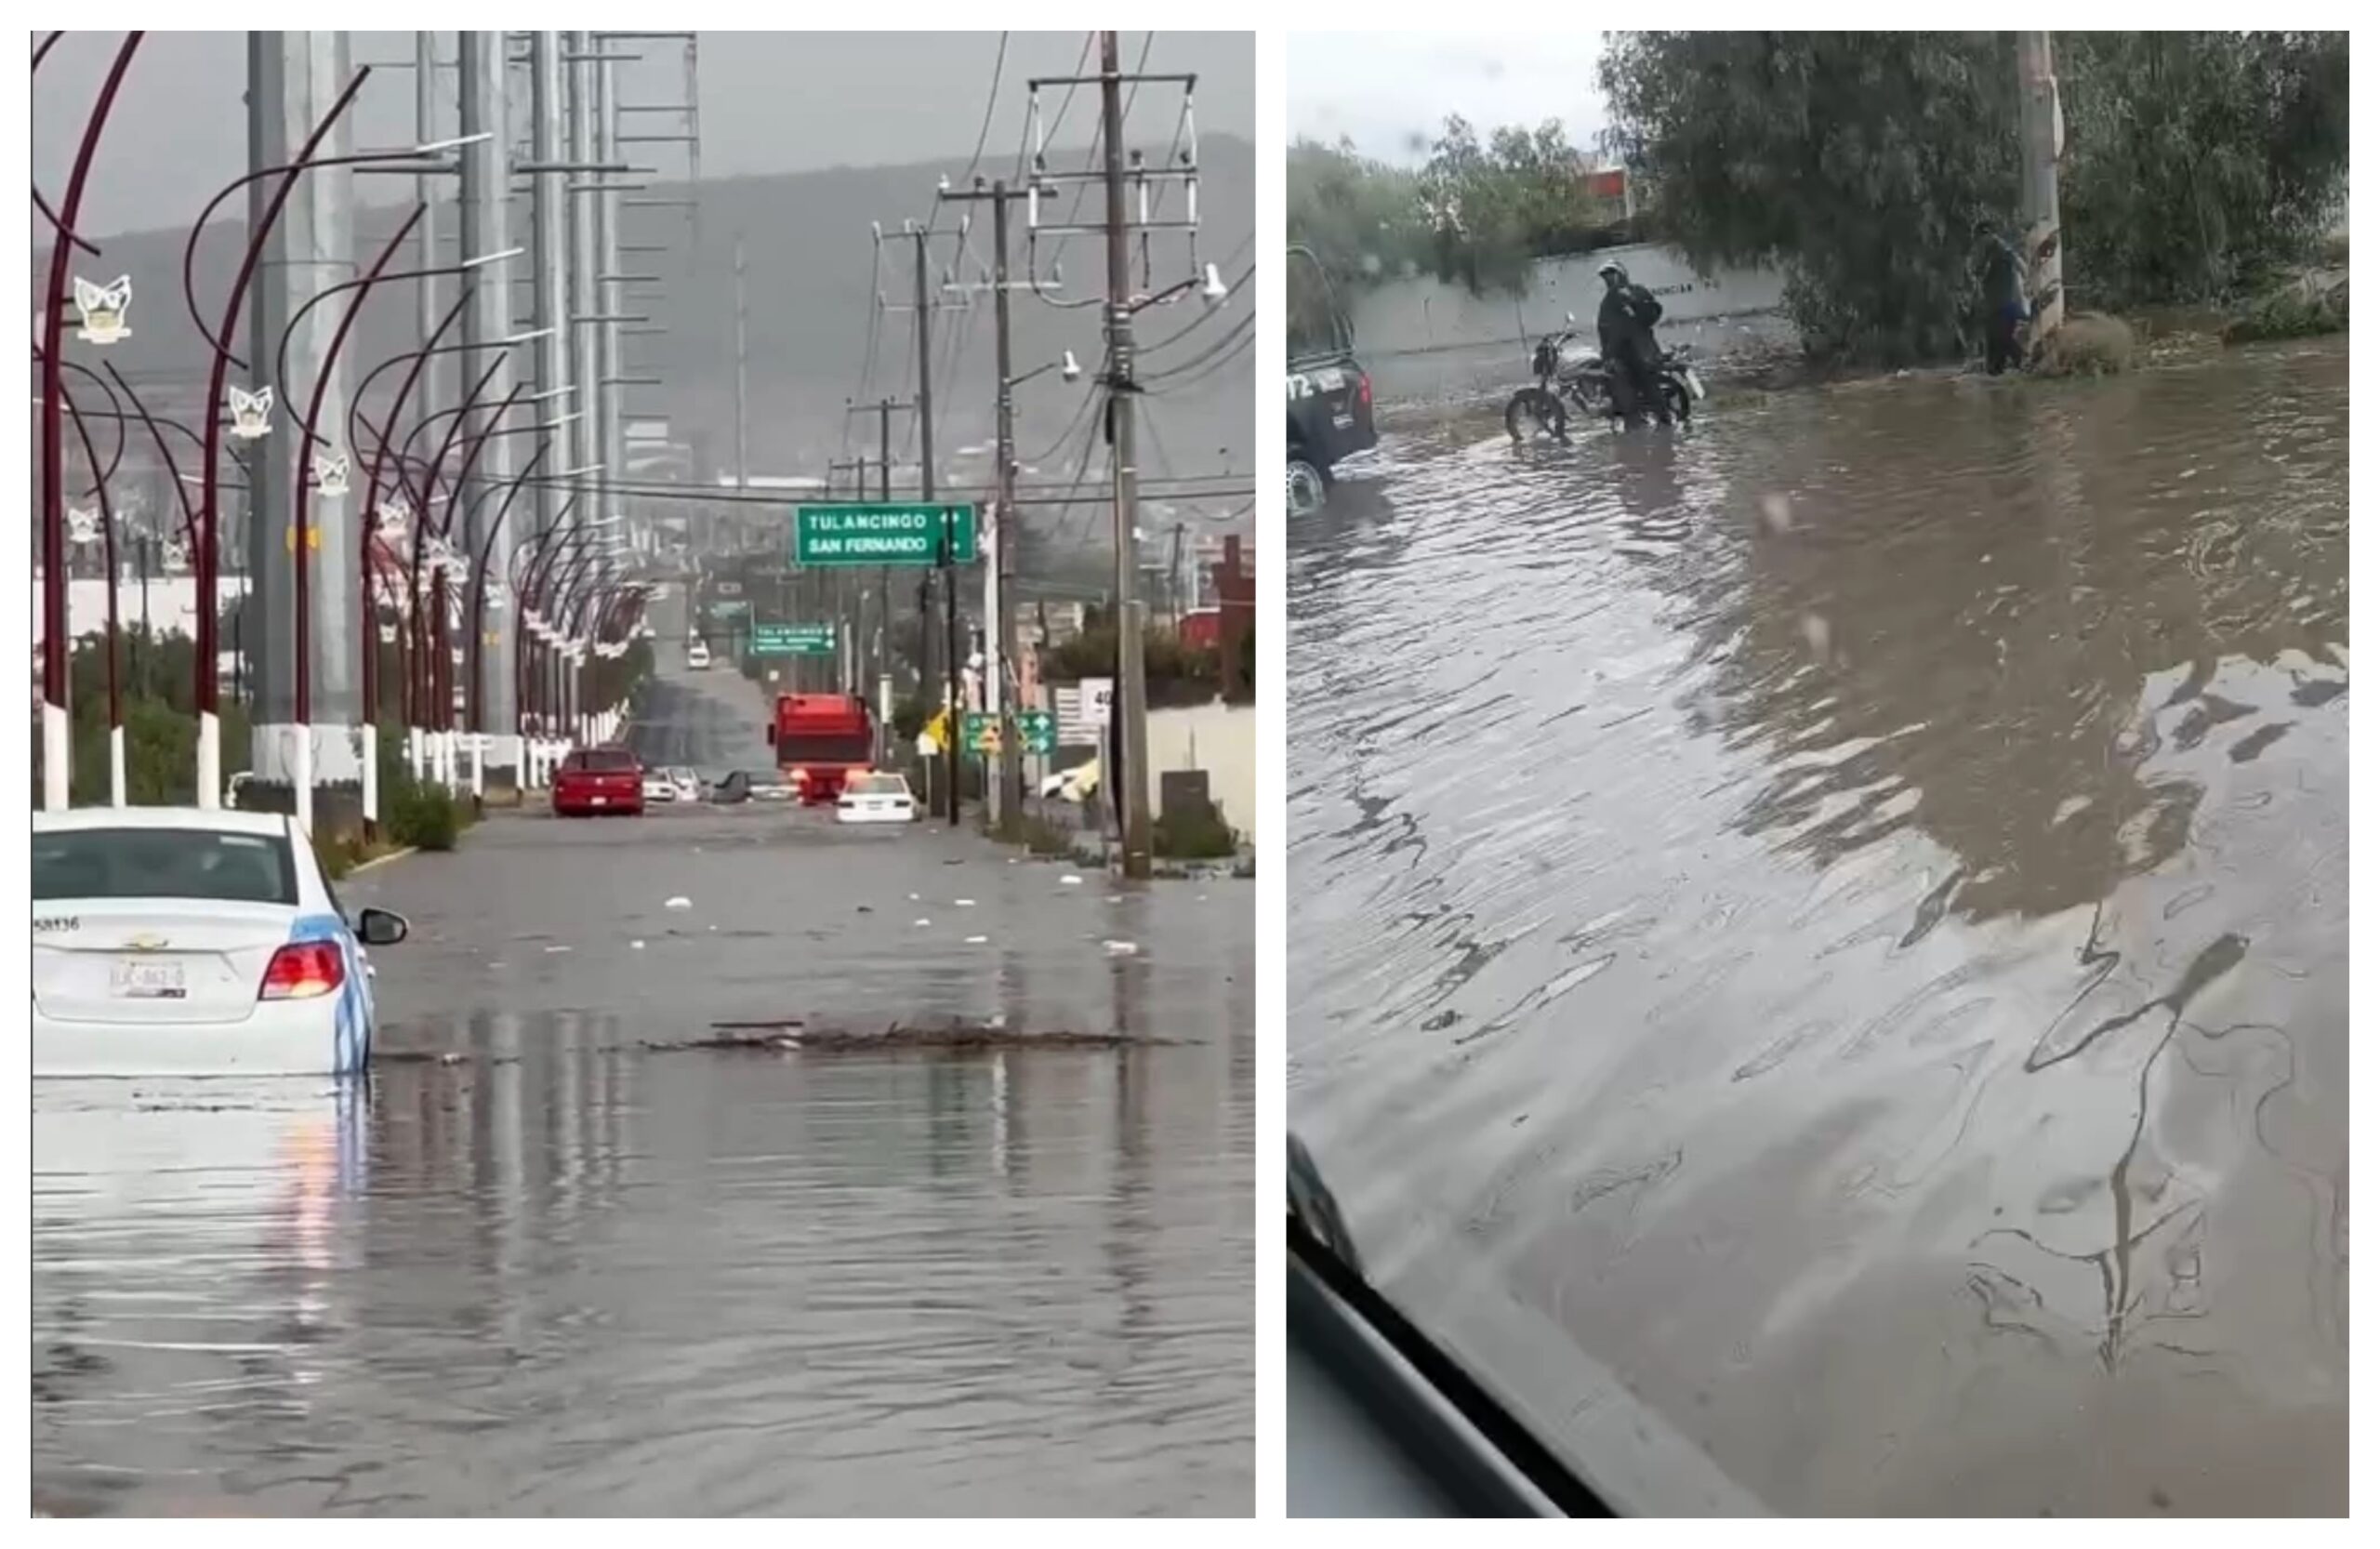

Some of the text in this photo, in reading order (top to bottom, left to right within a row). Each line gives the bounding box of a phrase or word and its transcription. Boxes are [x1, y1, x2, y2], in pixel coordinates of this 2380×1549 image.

[808, 514, 926, 530] TULANCINGO
[808, 537, 926, 553] SAN FERNANDO
